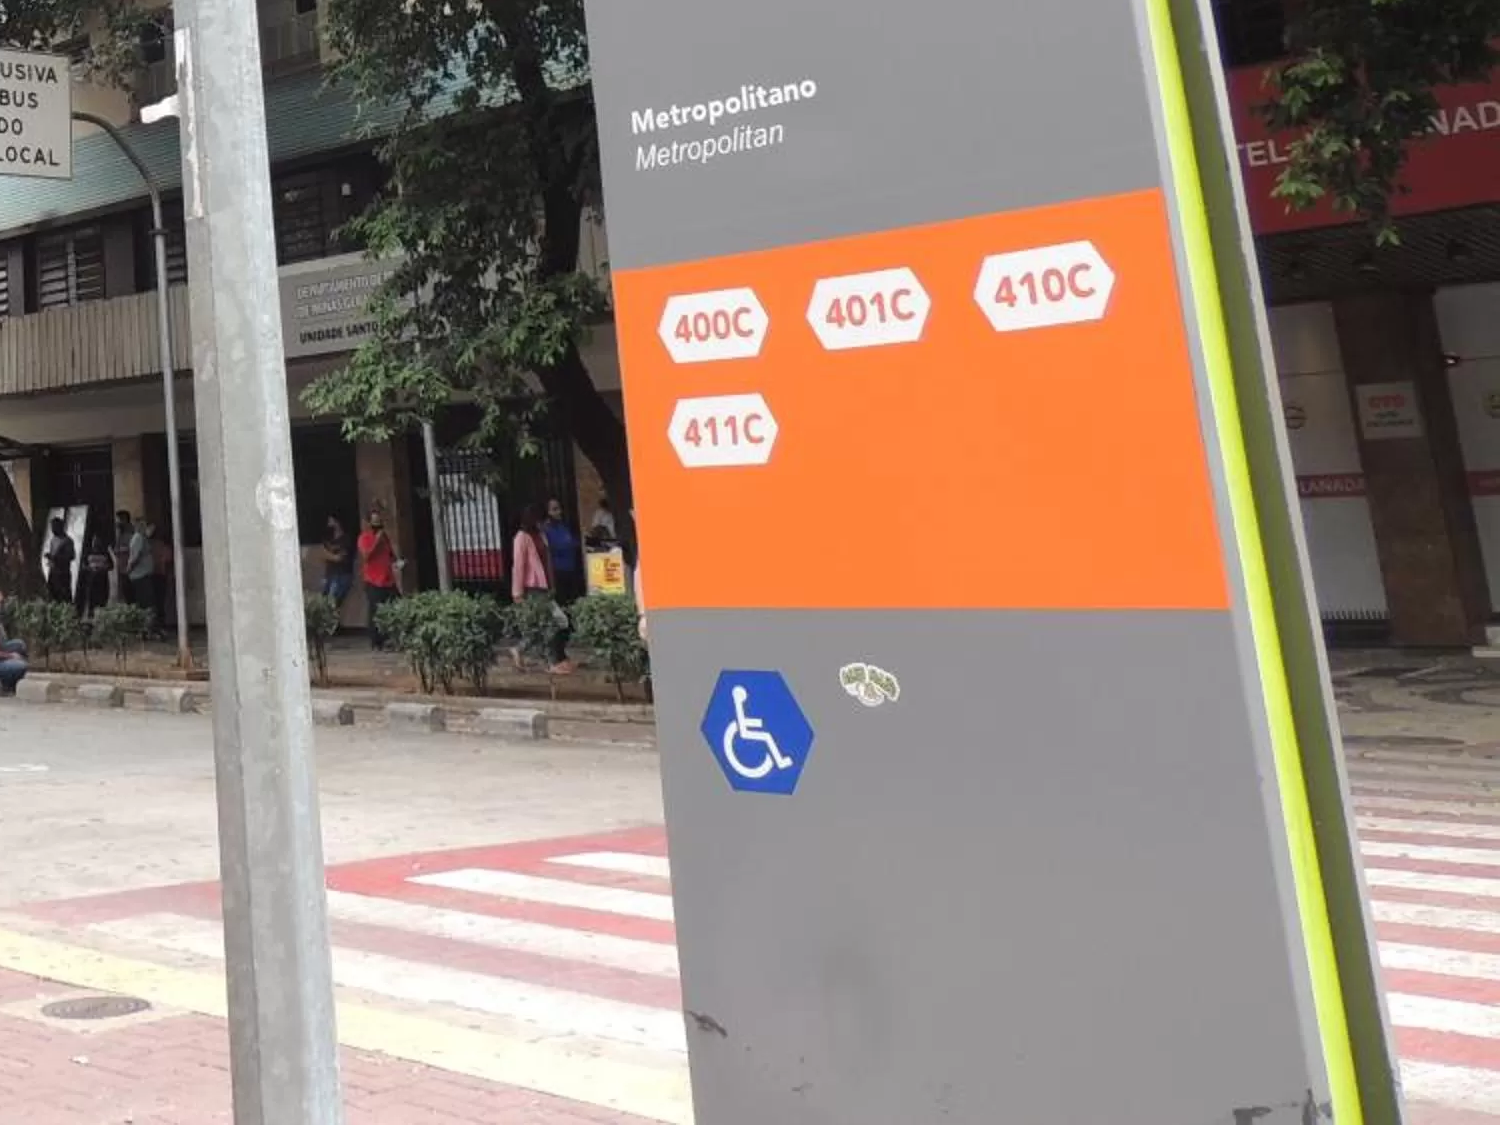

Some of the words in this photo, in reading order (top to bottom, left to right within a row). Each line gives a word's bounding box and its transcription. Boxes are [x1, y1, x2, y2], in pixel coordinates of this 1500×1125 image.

[631, 79, 817, 135] Metropolitano
[635, 124, 784, 171] Metropolitan
[994, 263, 1096, 308] 410C
[674, 307, 754, 344] 400C
[825, 288, 916, 329] 401C
[683, 412, 765, 447] 411C
